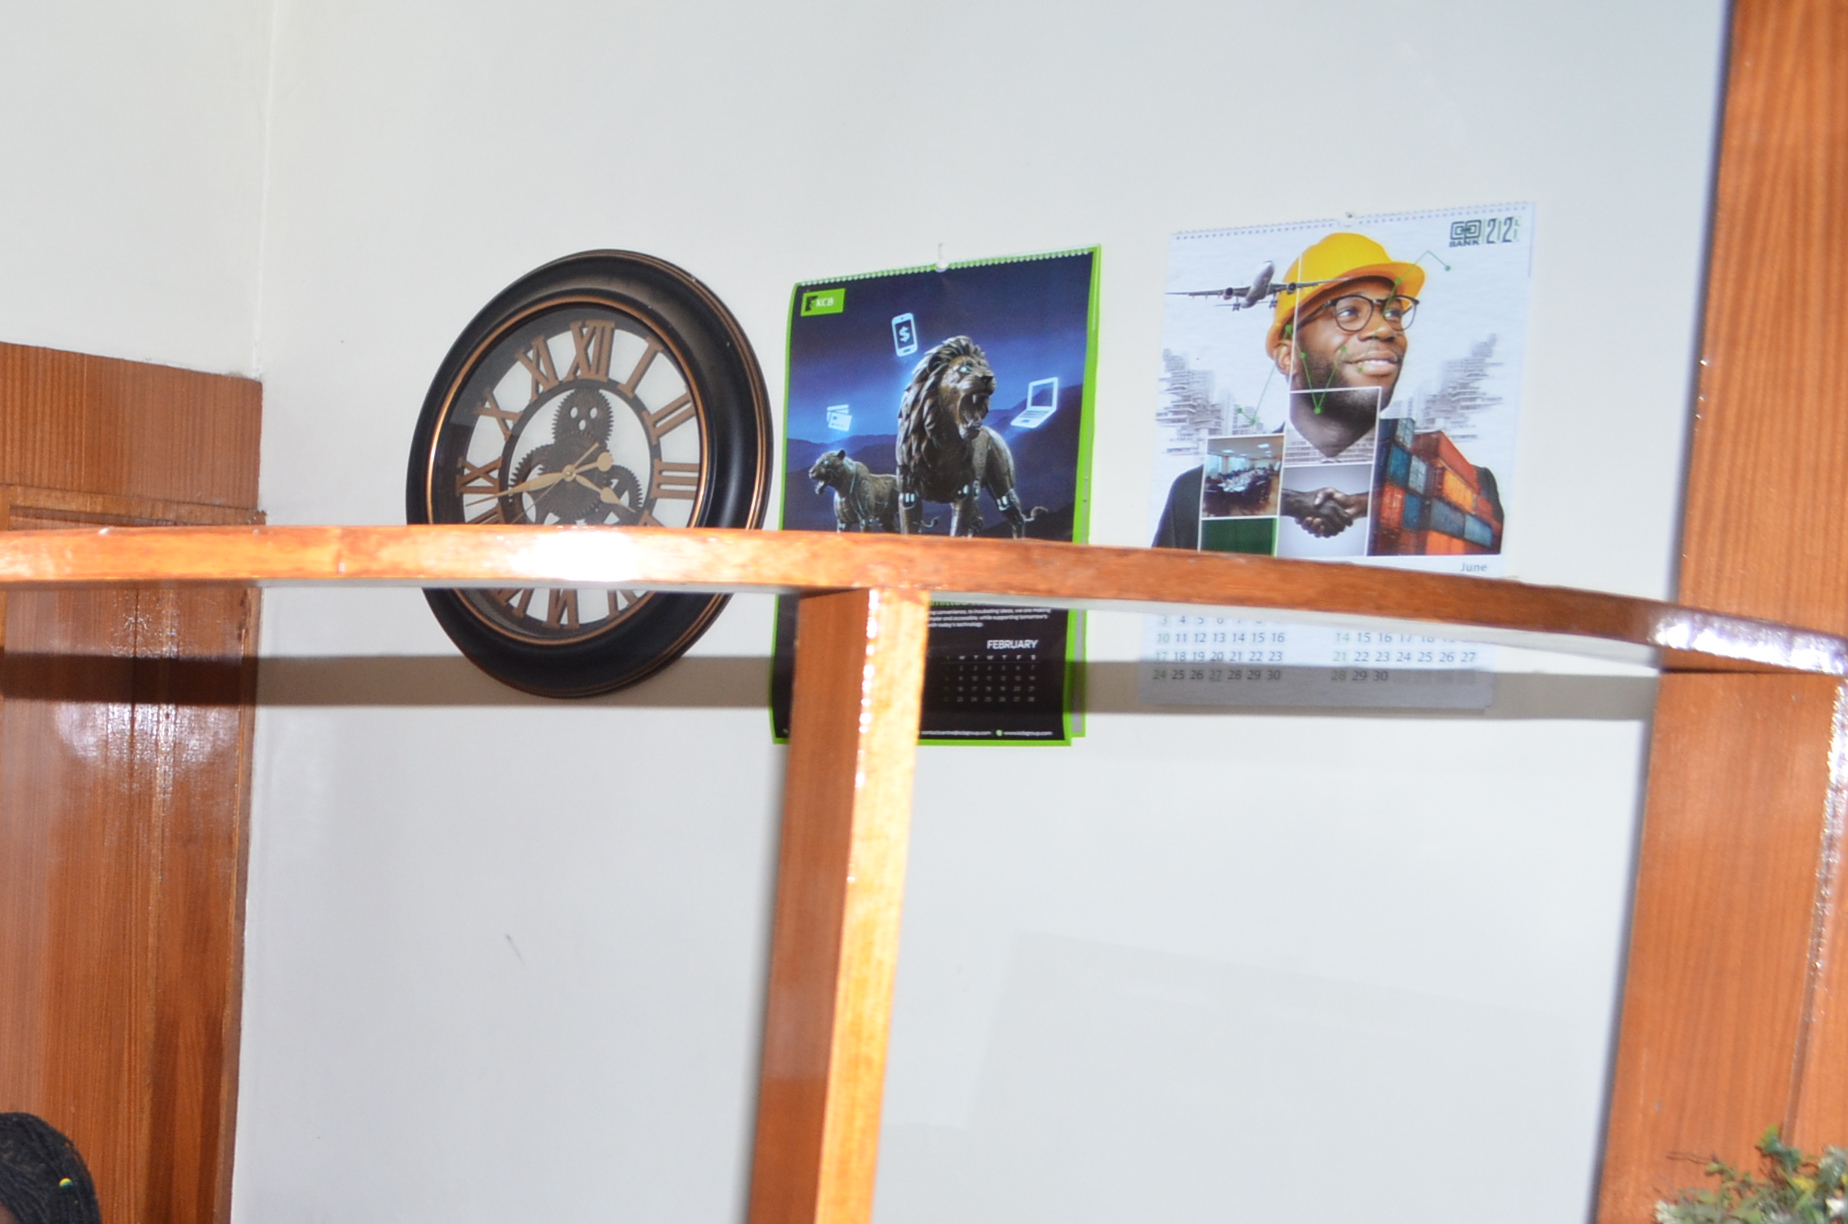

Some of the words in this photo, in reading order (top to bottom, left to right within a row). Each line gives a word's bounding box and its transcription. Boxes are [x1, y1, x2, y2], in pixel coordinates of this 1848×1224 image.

[1449, 240, 1480, 248] BANK
[816, 297, 834, 308] KCB
[1460, 563, 1488, 572] June
[1176, 633, 1187, 643] 11
[1194, 633, 1207, 643] 12
[1213, 633, 1226, 643] 13
[1232, 633, 1245, 643] 14
[1252, 633, 1265, 643] 15
[1272, 633, 1285, 643] 16
[1336, 632, 1350, 643] 14
[1357, 632, 1371, 643] 15
[1379, 632, 1392, 643] 16
[986, 639, 1039, 650] FEBRUARY
[1174, 651, 1186, 662] 18
[1193, 651, 1205, 662] 19
[1210, 651, 1224, 662] 20
[1229, 651, 1242, 662] 21
[1249, 651, 1263, 662] 22
[1268, 651, 1283, 662] 23
[1332, 651, 1346, 662] 21
[1354, 651, 1369, 662] 22
[1375, 651, 1390, 662] 23
[1396, 651, 1411, 662] 24
[1417, 651, 1433, 662] 25
[1438, 651, 1455, 662] 26
[1460, 651, 1476, 662] 27
[1172, 669, 1185, 680] 25
[1189, 669, 1203, 680] 26
[1209, 669, 1222, 680] 27
[1227, 669, 1242, 680] 28
[1246, 669, 1261, 680] 29
[1266, 669, 1281, 680] 30
[1352, 670, 1368, 682] 29
[1372, 670, 1389, 682] 30
